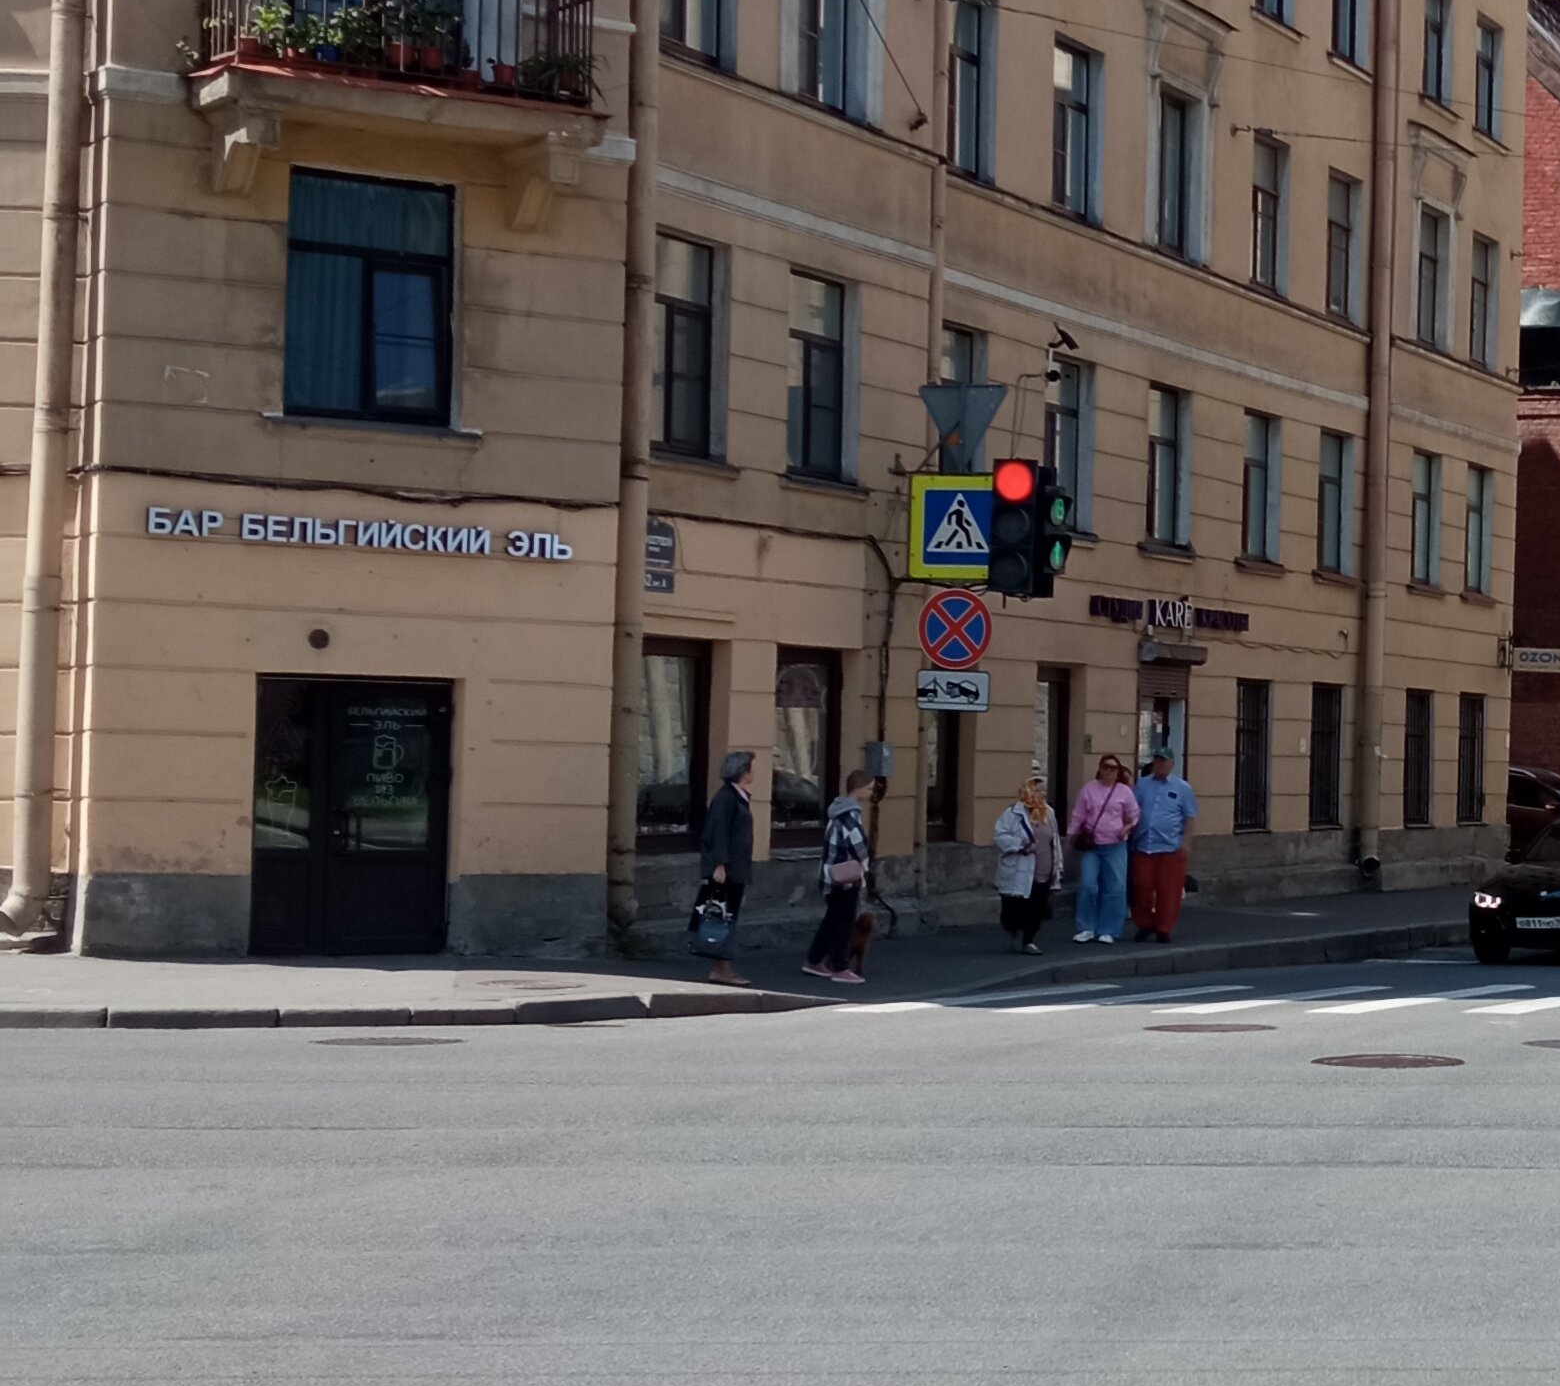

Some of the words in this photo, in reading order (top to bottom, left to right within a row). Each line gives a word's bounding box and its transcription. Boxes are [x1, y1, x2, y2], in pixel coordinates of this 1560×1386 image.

[146, 506, 224, 538] БАР
[240, 512, 491, 555] БЕЛЬГИЙСКИЙ
[505, 530, 574, 560] ЭЛЬ
[366, 772, 404, 783] ПИВО
